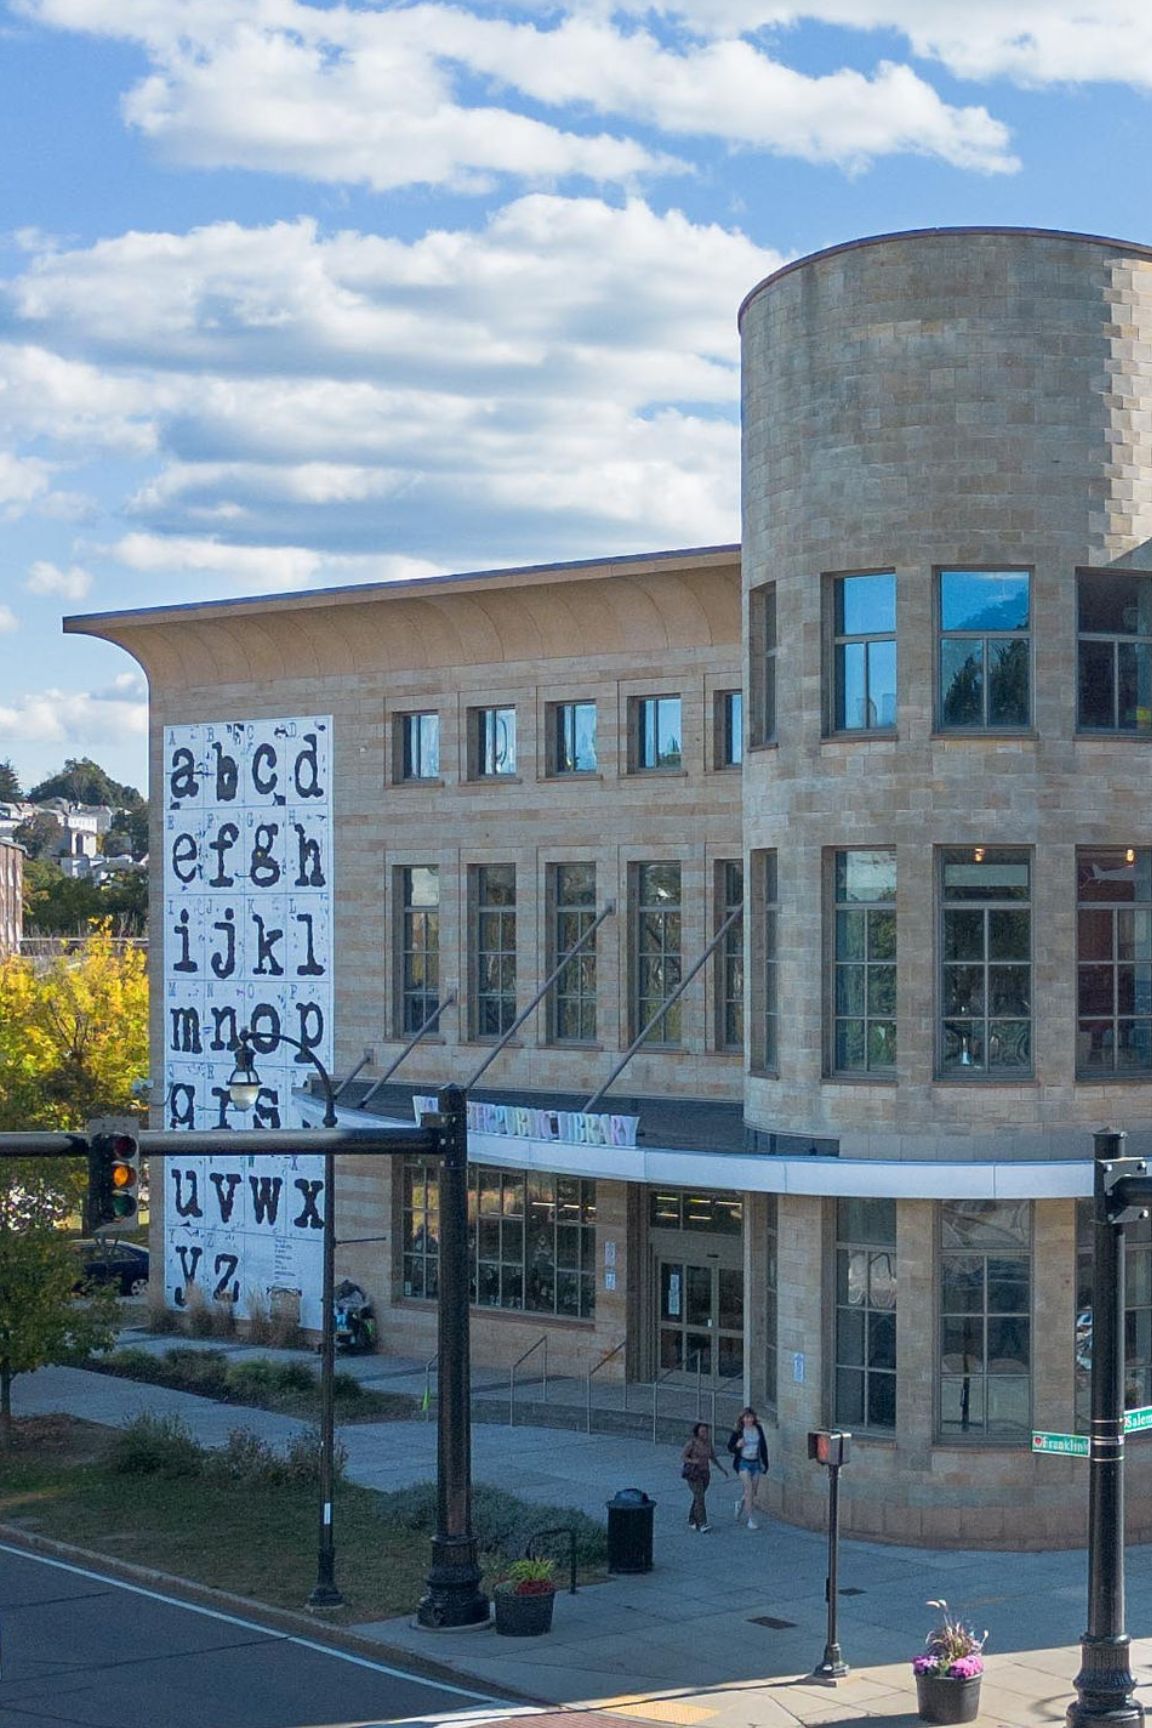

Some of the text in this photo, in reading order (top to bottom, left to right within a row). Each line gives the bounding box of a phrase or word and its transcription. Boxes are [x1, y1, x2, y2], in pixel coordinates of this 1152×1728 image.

[495, 1105, 557, 1140] PUBLIC
[558, 1111, 640, 1146] LIBRARY
[1125, 1411, 1152, 1429] Salem
[1042, 1436, 1083, 1454] Franklin
